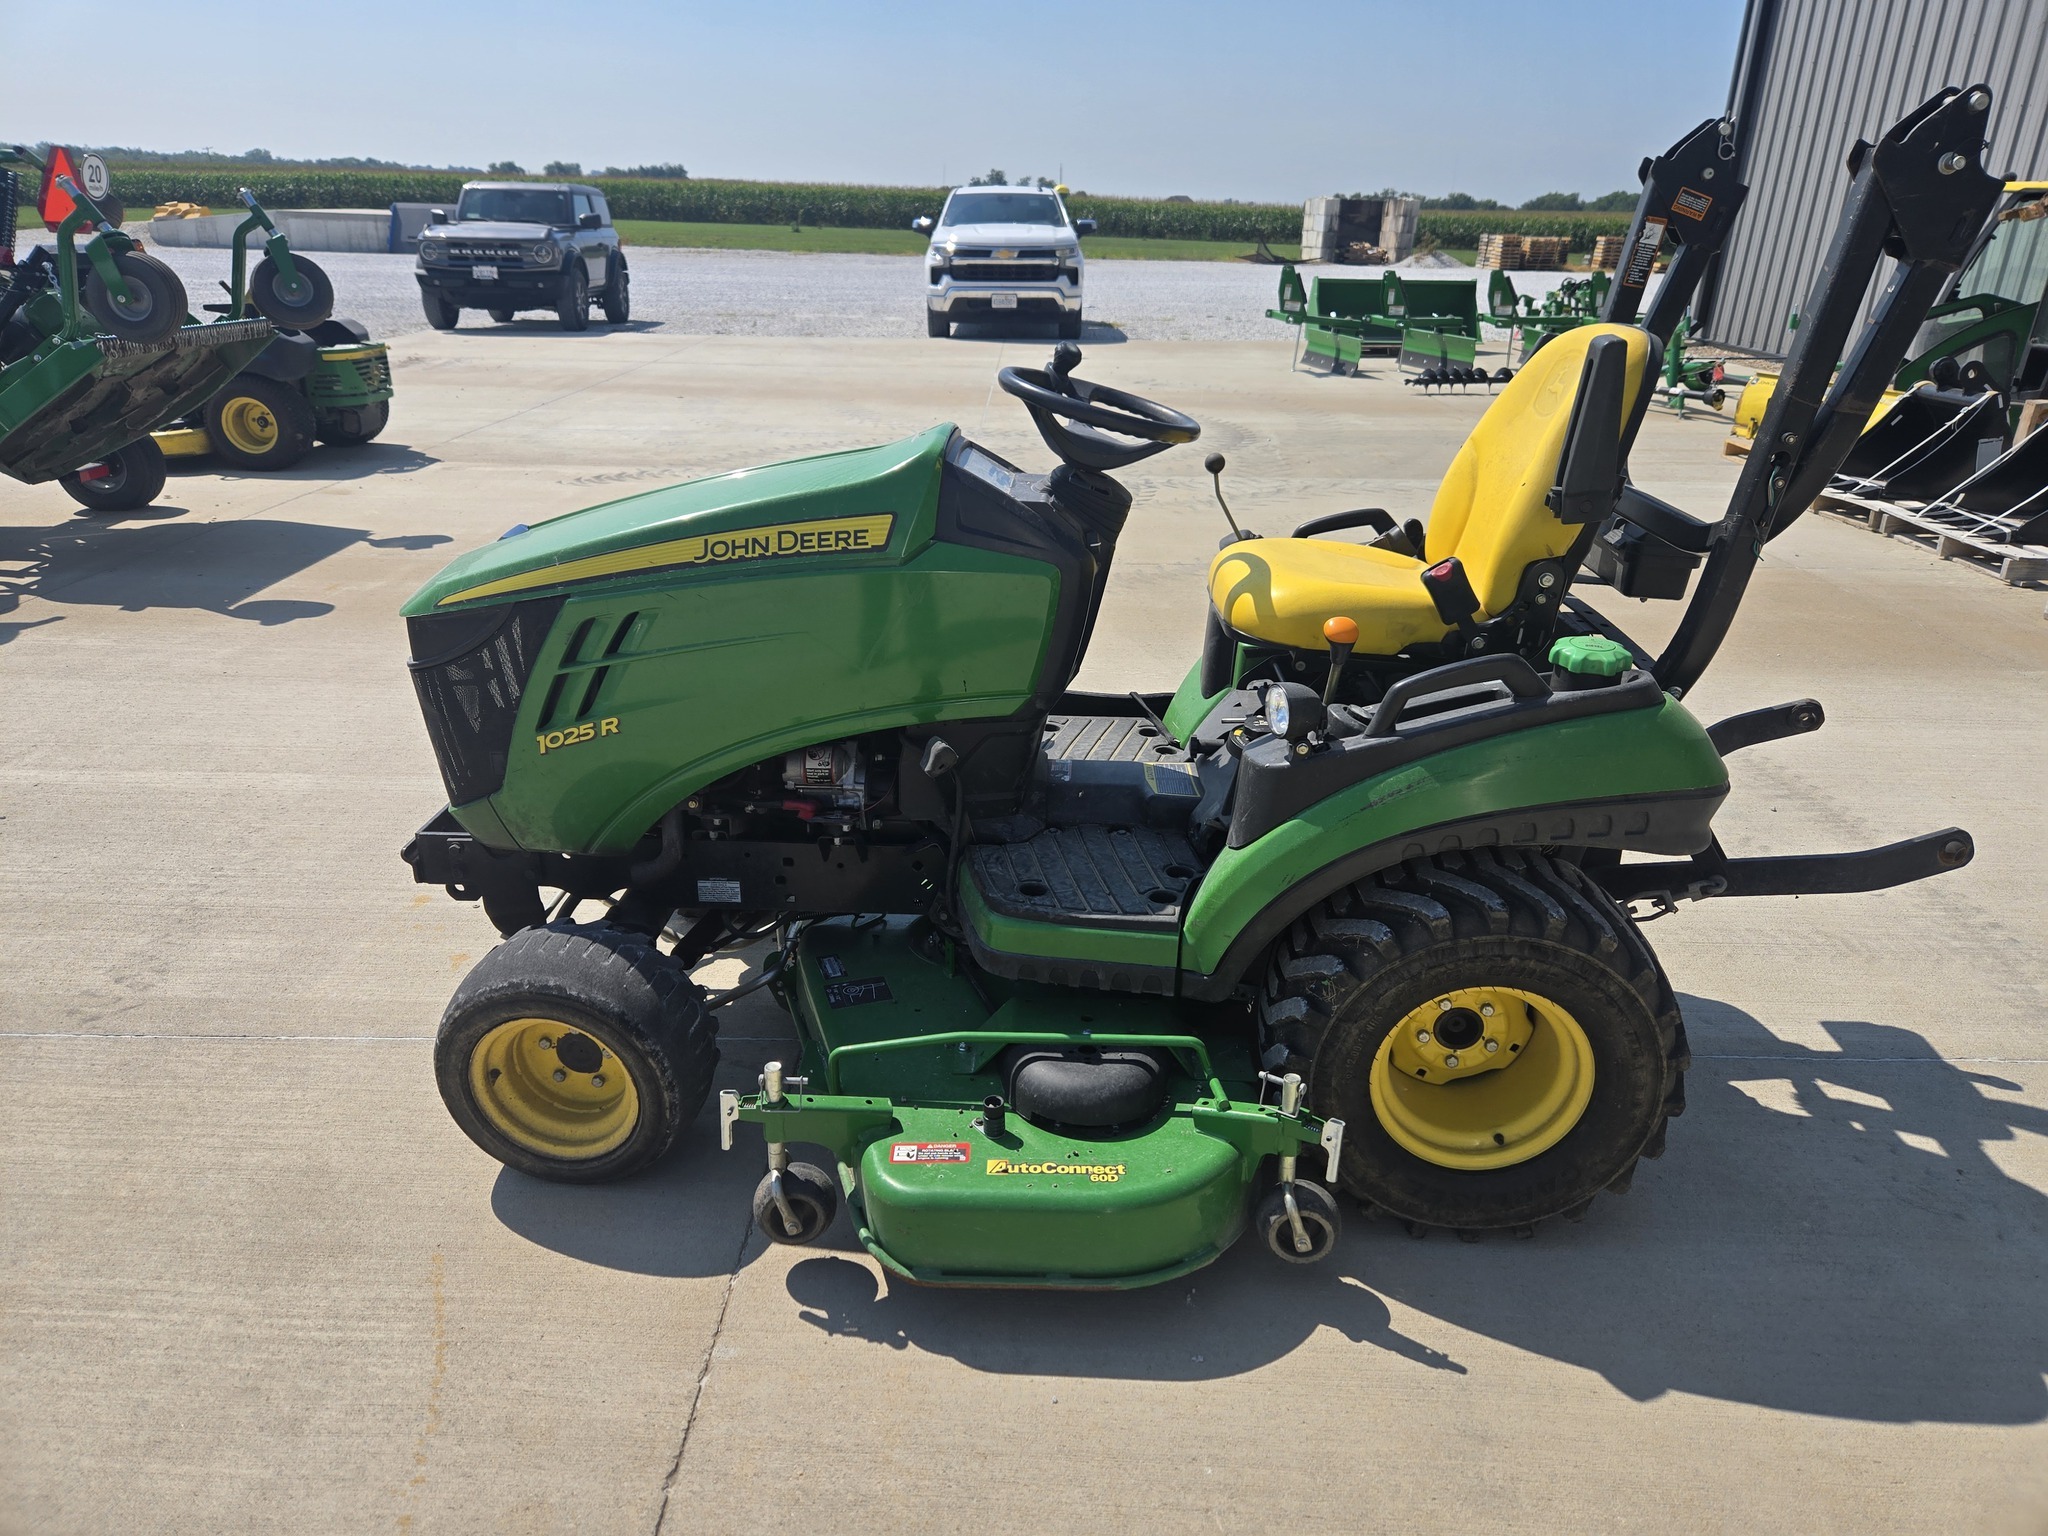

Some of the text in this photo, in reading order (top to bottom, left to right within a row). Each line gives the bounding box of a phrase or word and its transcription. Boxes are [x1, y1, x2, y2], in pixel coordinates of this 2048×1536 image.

[87, 164, 102, 184] 20
[693, 529, 870, 562] JOHN DEERE
[536, 717, 620, 755] 1025 R
[987, 1160, 1126, 1175] AutoConnect
[1090, 1173, 1119, 1182] 60D
